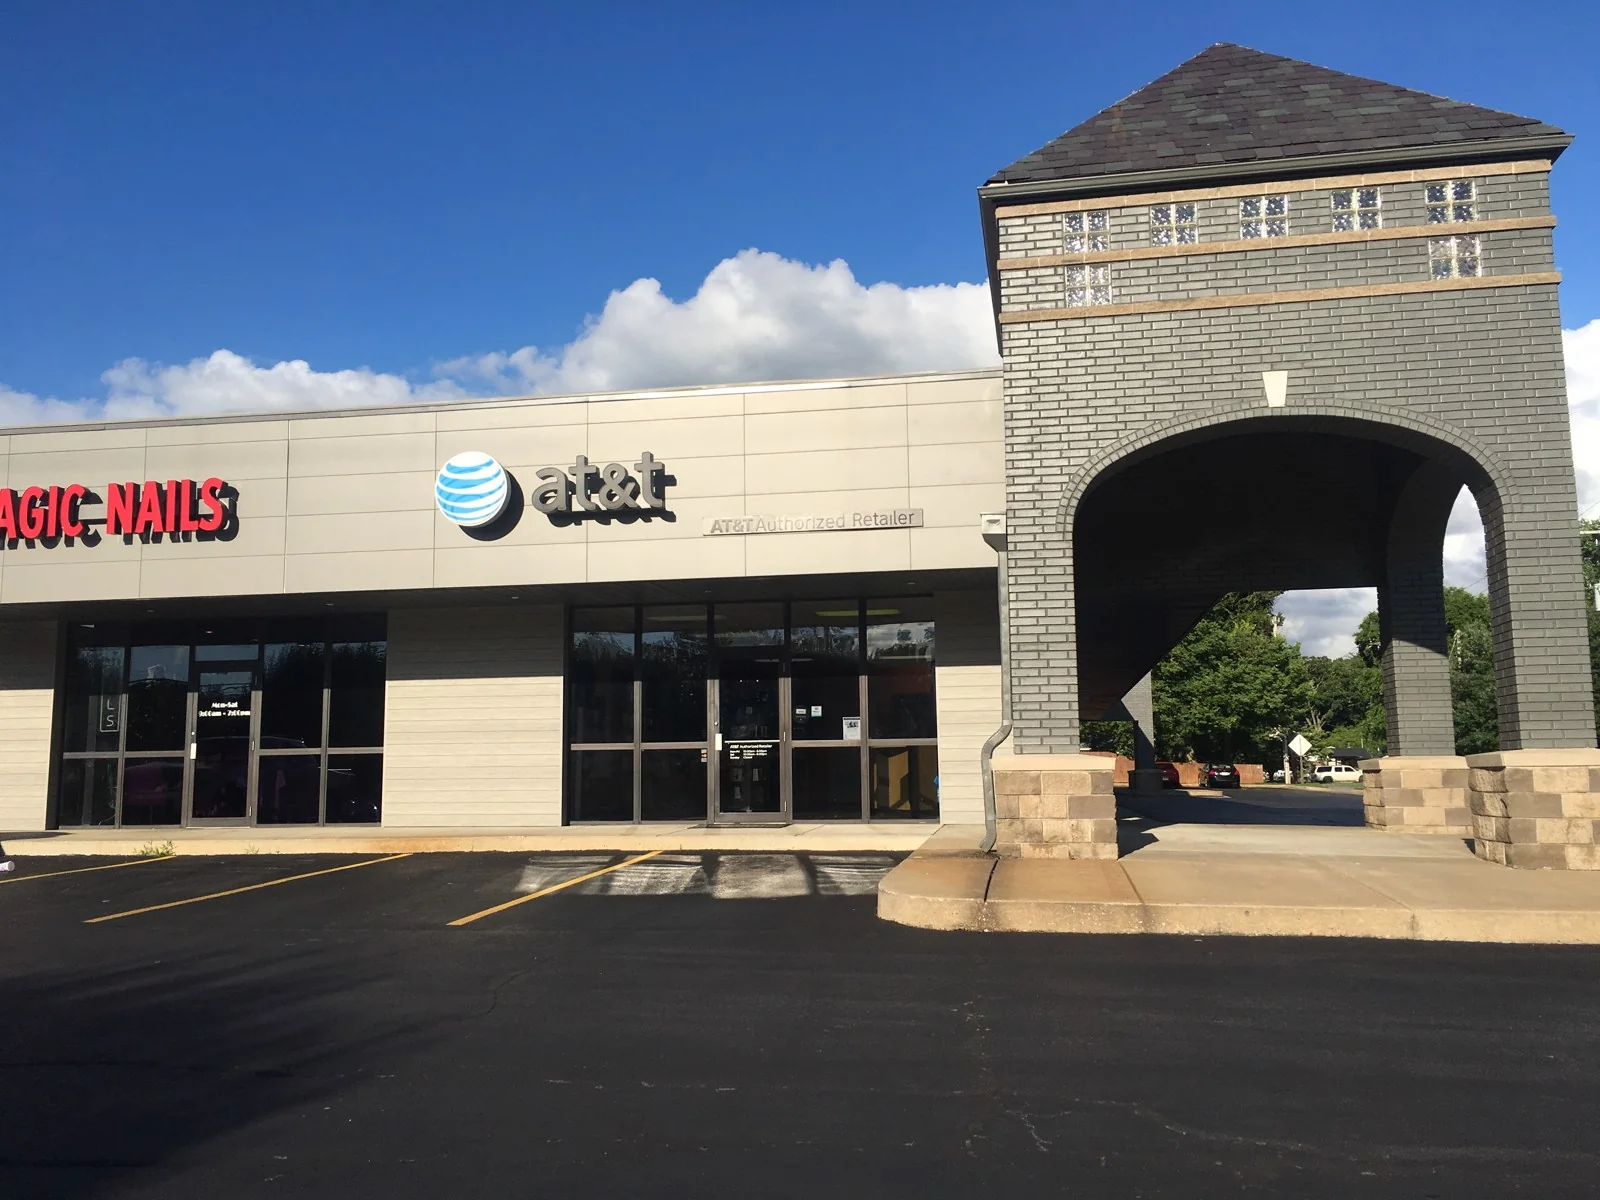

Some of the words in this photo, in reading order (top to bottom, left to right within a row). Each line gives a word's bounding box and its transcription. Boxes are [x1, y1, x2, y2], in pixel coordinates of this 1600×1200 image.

[107, 477, 224, 535] NAILS
[531, 451, 664, 514] at&t
[710, 519, 753, 534] AT&T
[756, 514, 845, 532] Authorized
[852, 510, 915, 527] Retailer
